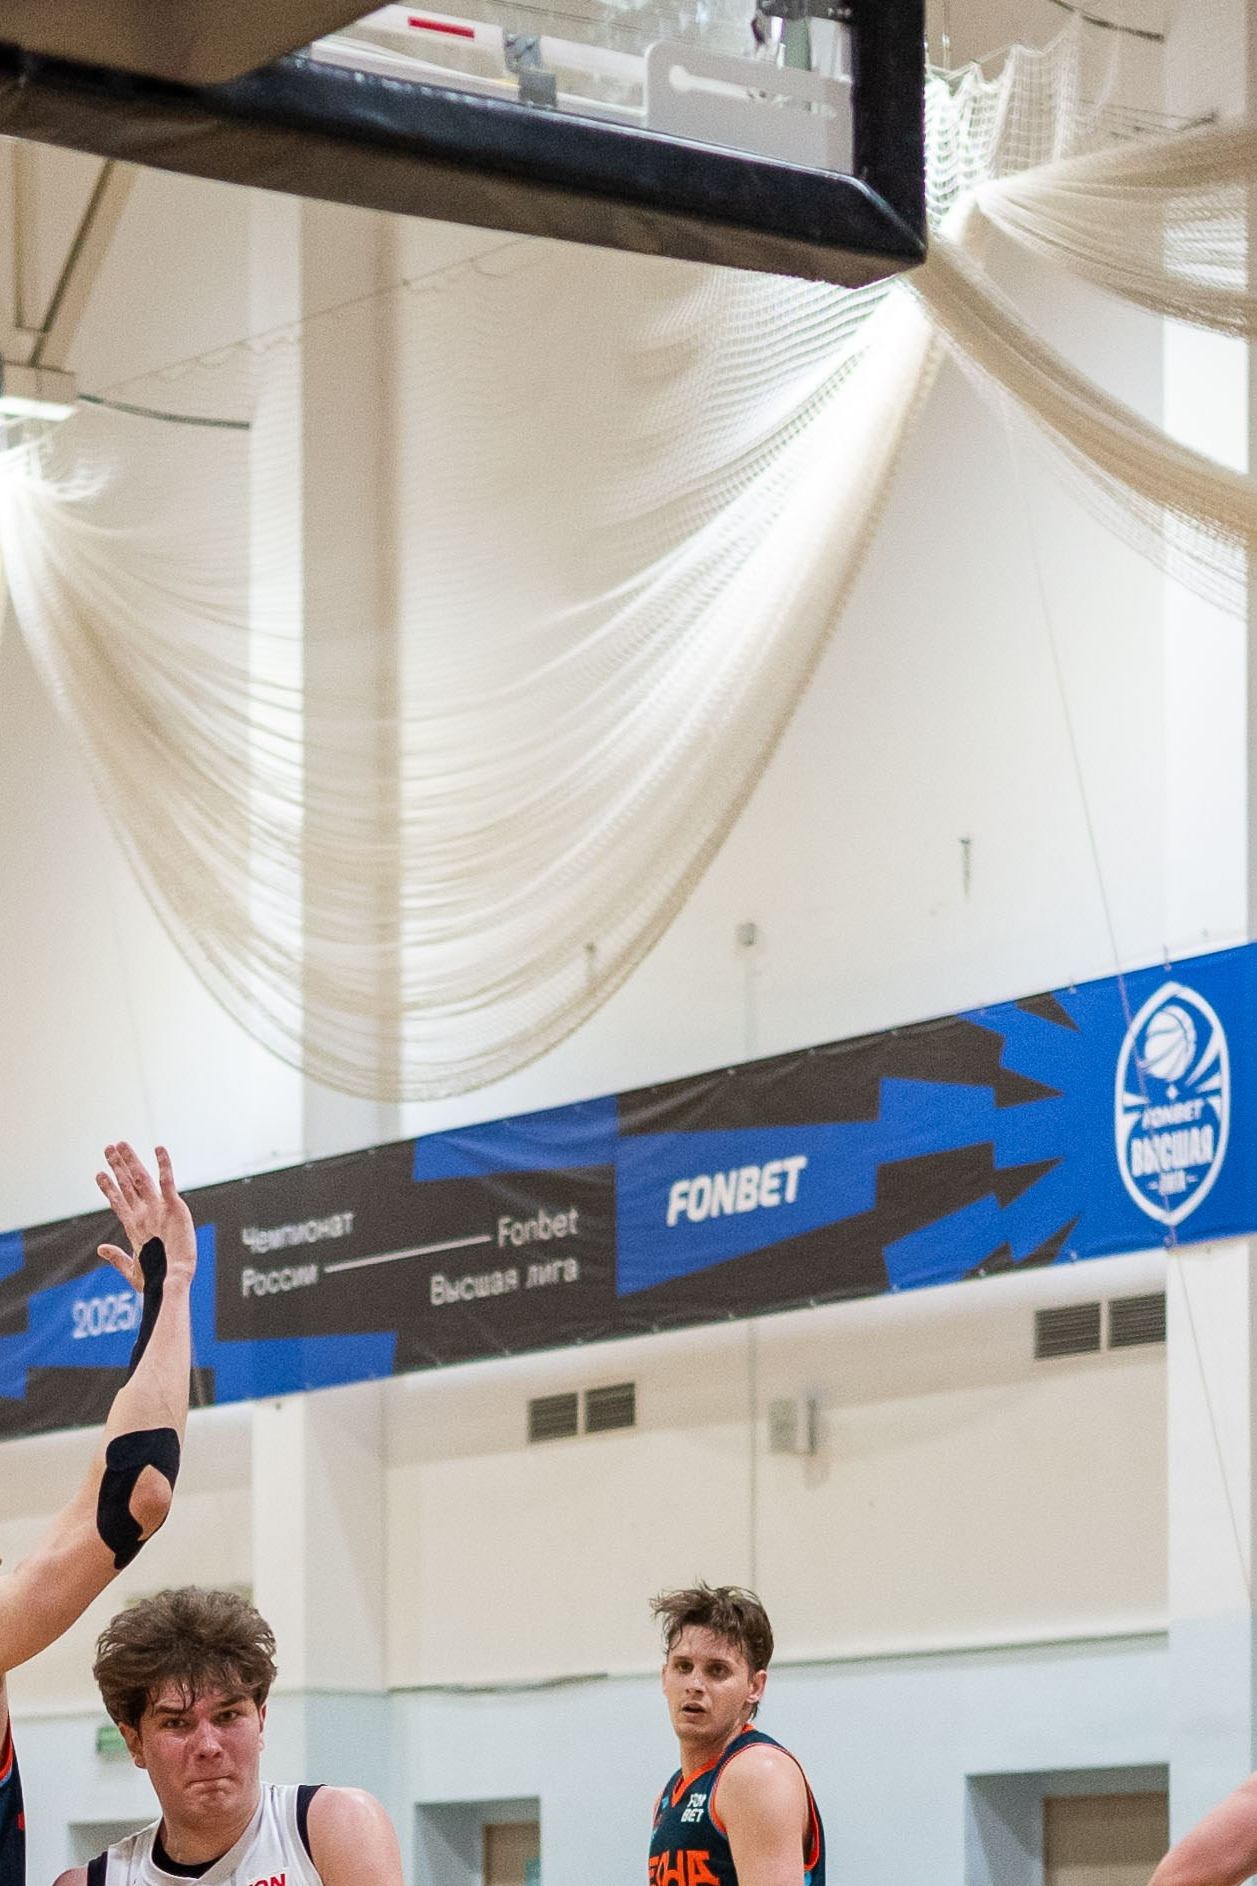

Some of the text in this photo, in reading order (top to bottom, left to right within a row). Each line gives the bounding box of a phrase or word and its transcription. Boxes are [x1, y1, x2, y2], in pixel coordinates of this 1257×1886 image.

[666, 1155, 808, 1228] FONBET
[498, 1207, 579, 1248] Fonbet
[242, 1264, 319, 1298] России
[430, 1257, 579, 1306] Высшая лига
[680, 1808, 704, 1823] BET
